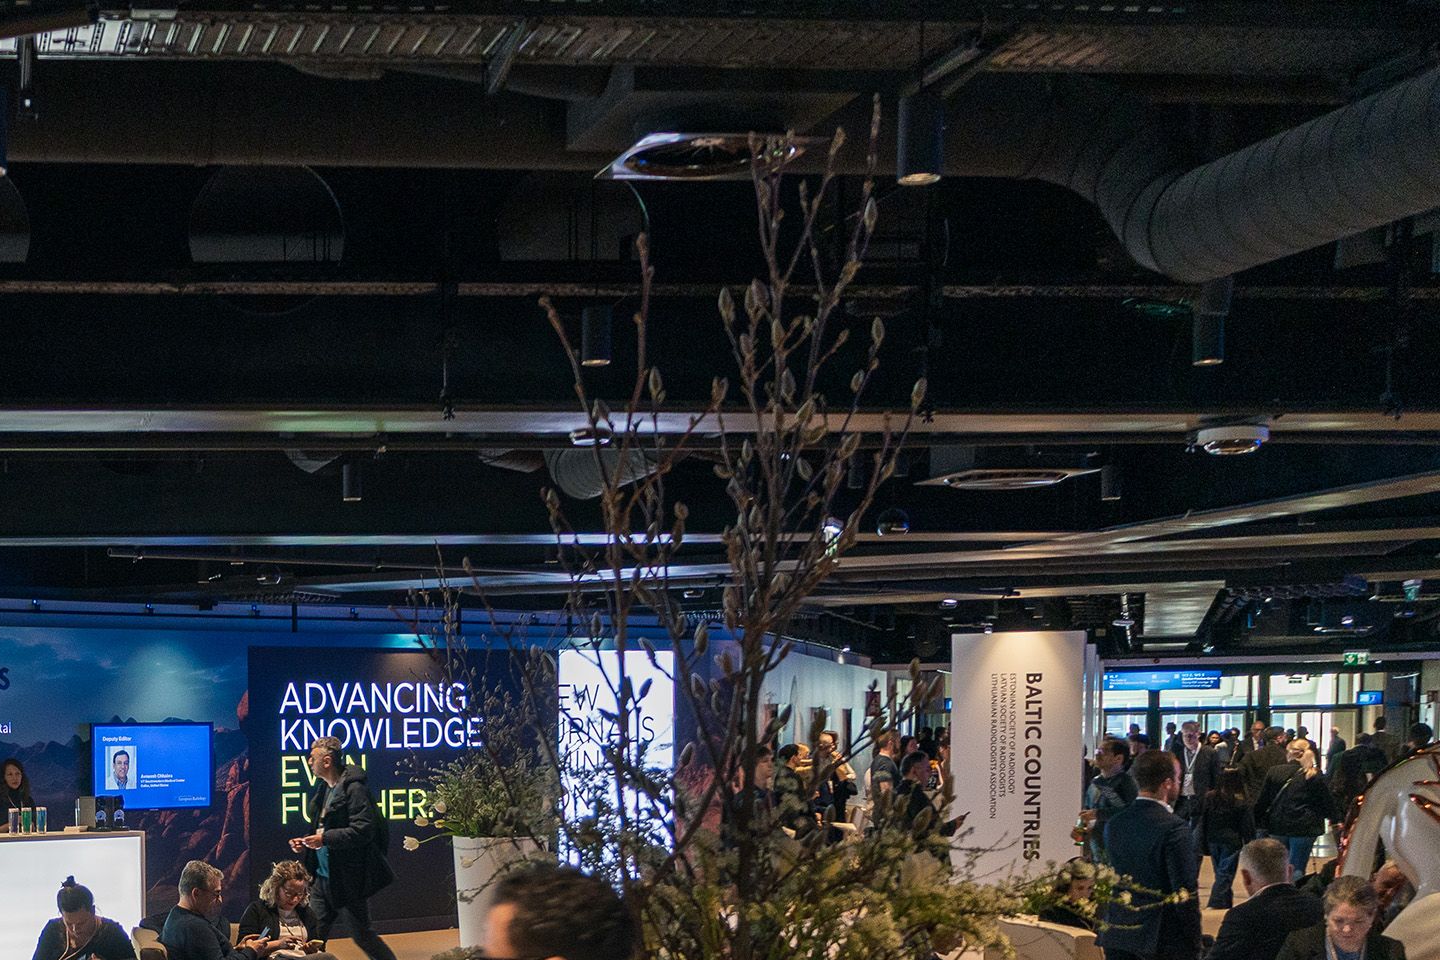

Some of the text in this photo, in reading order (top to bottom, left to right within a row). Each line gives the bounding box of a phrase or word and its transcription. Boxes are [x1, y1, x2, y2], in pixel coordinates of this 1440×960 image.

[279, 682, 467, 714] ADVANCING
[1000, 673, 1008, 703] LATVIAN
[280, 717, 484, 750] KNOWLEDGE
[988, 673, 998, 819] LITHUANIAN RADIOLOGISTS ASSOCIATION
[999, 735, 1007, 745] OF
[1007, 673, 1017, 795] ESTONIAN SOCIETY OF RADIOLOGY
[998, 746, 1006, 797] RADIOLOGISTS
[1022, 672, 1043, 861] BALTIC COUNTRIES
